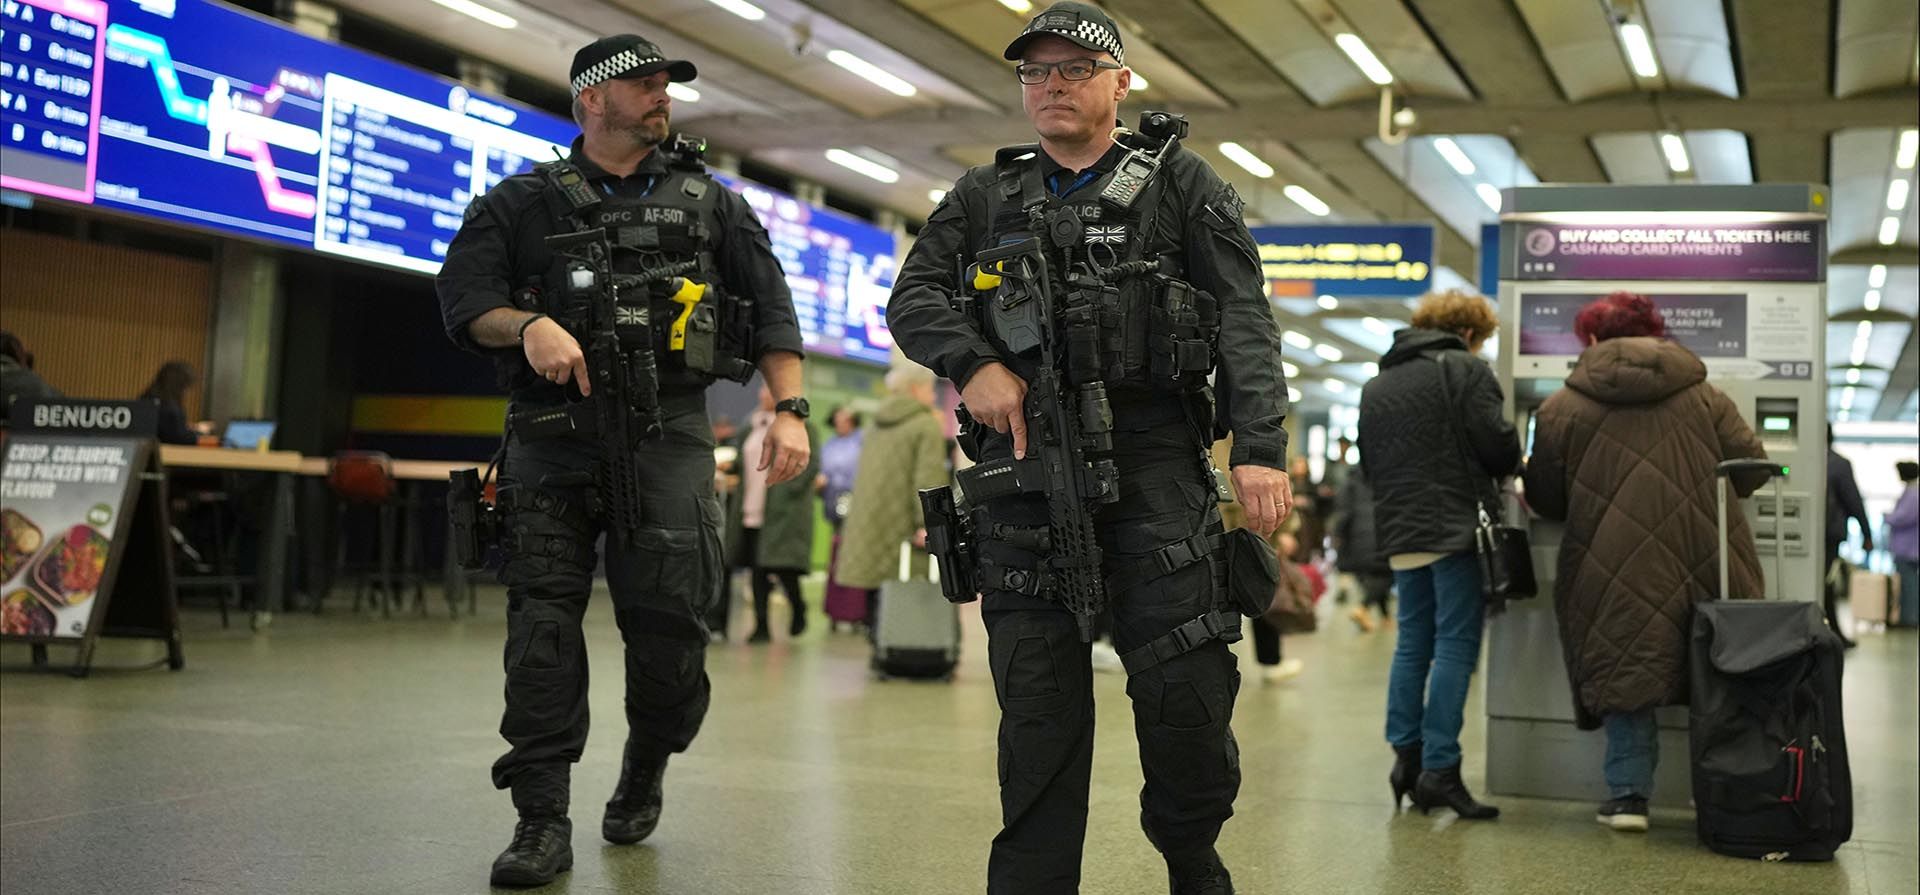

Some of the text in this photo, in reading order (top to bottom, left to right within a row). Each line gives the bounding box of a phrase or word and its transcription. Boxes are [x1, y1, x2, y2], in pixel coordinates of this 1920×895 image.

[601, 211, 632, 223] OFC
[644, 208, 684, 224] AF-507
[1072, 205, 1102, 218] LICE
[1559, 229, 1811, 243] BUY AND COLLECT ALL TICKETS HERE
[1559, 243, 1743, 256] CASH AND CARD PAYMENTS
[34, 404, 131, 429] BENUGO
